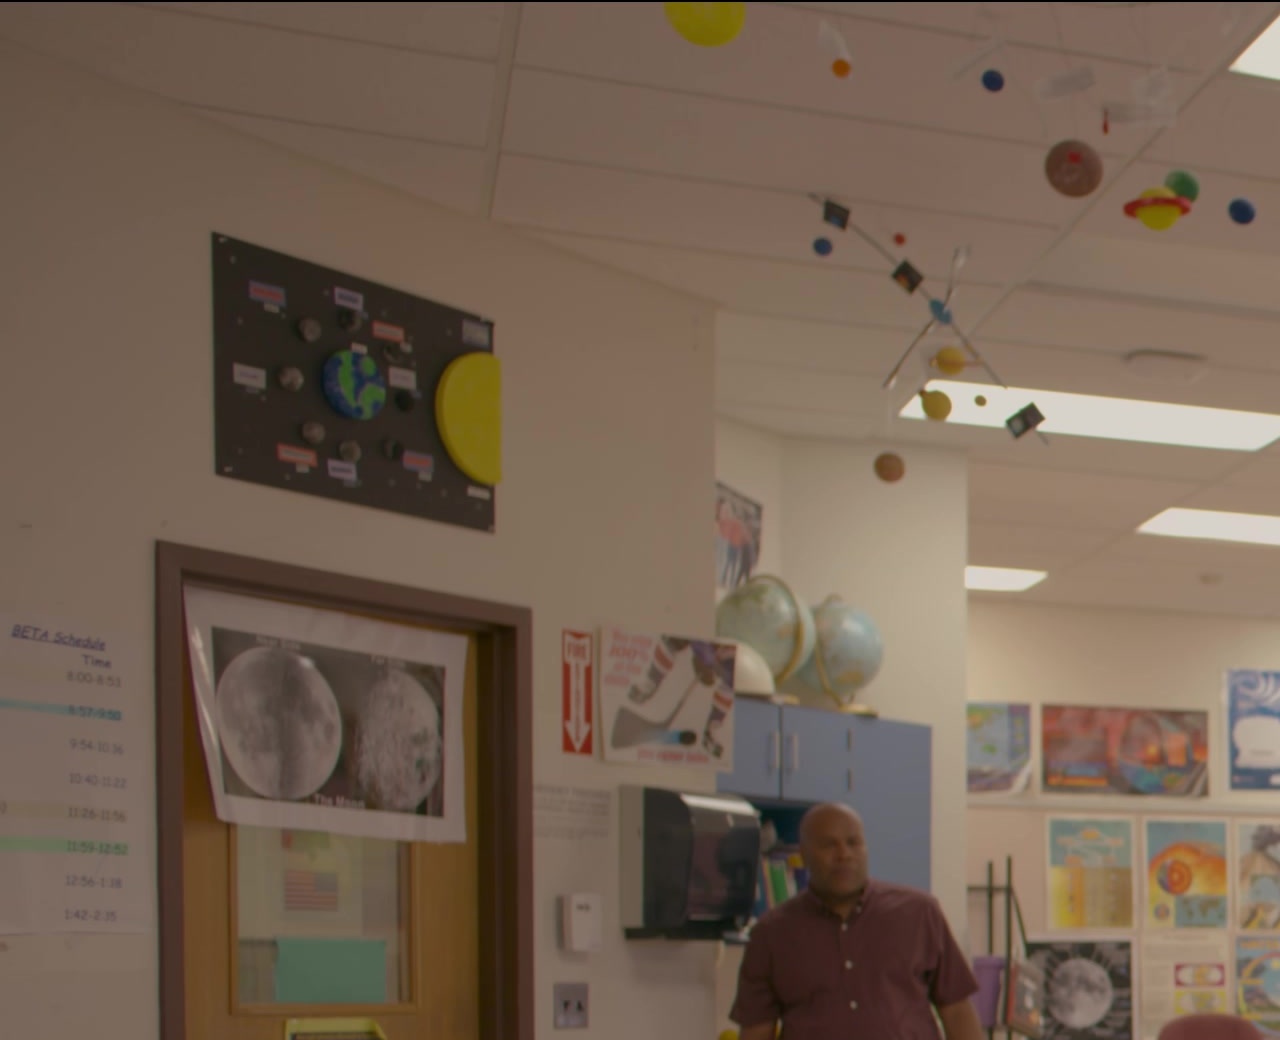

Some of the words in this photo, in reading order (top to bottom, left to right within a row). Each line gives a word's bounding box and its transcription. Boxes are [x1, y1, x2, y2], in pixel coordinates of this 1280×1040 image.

[11, 624, 49, 642] BETA
[54, 632, 106, 652] Schedule
[81, 653, 112, 669] Time
